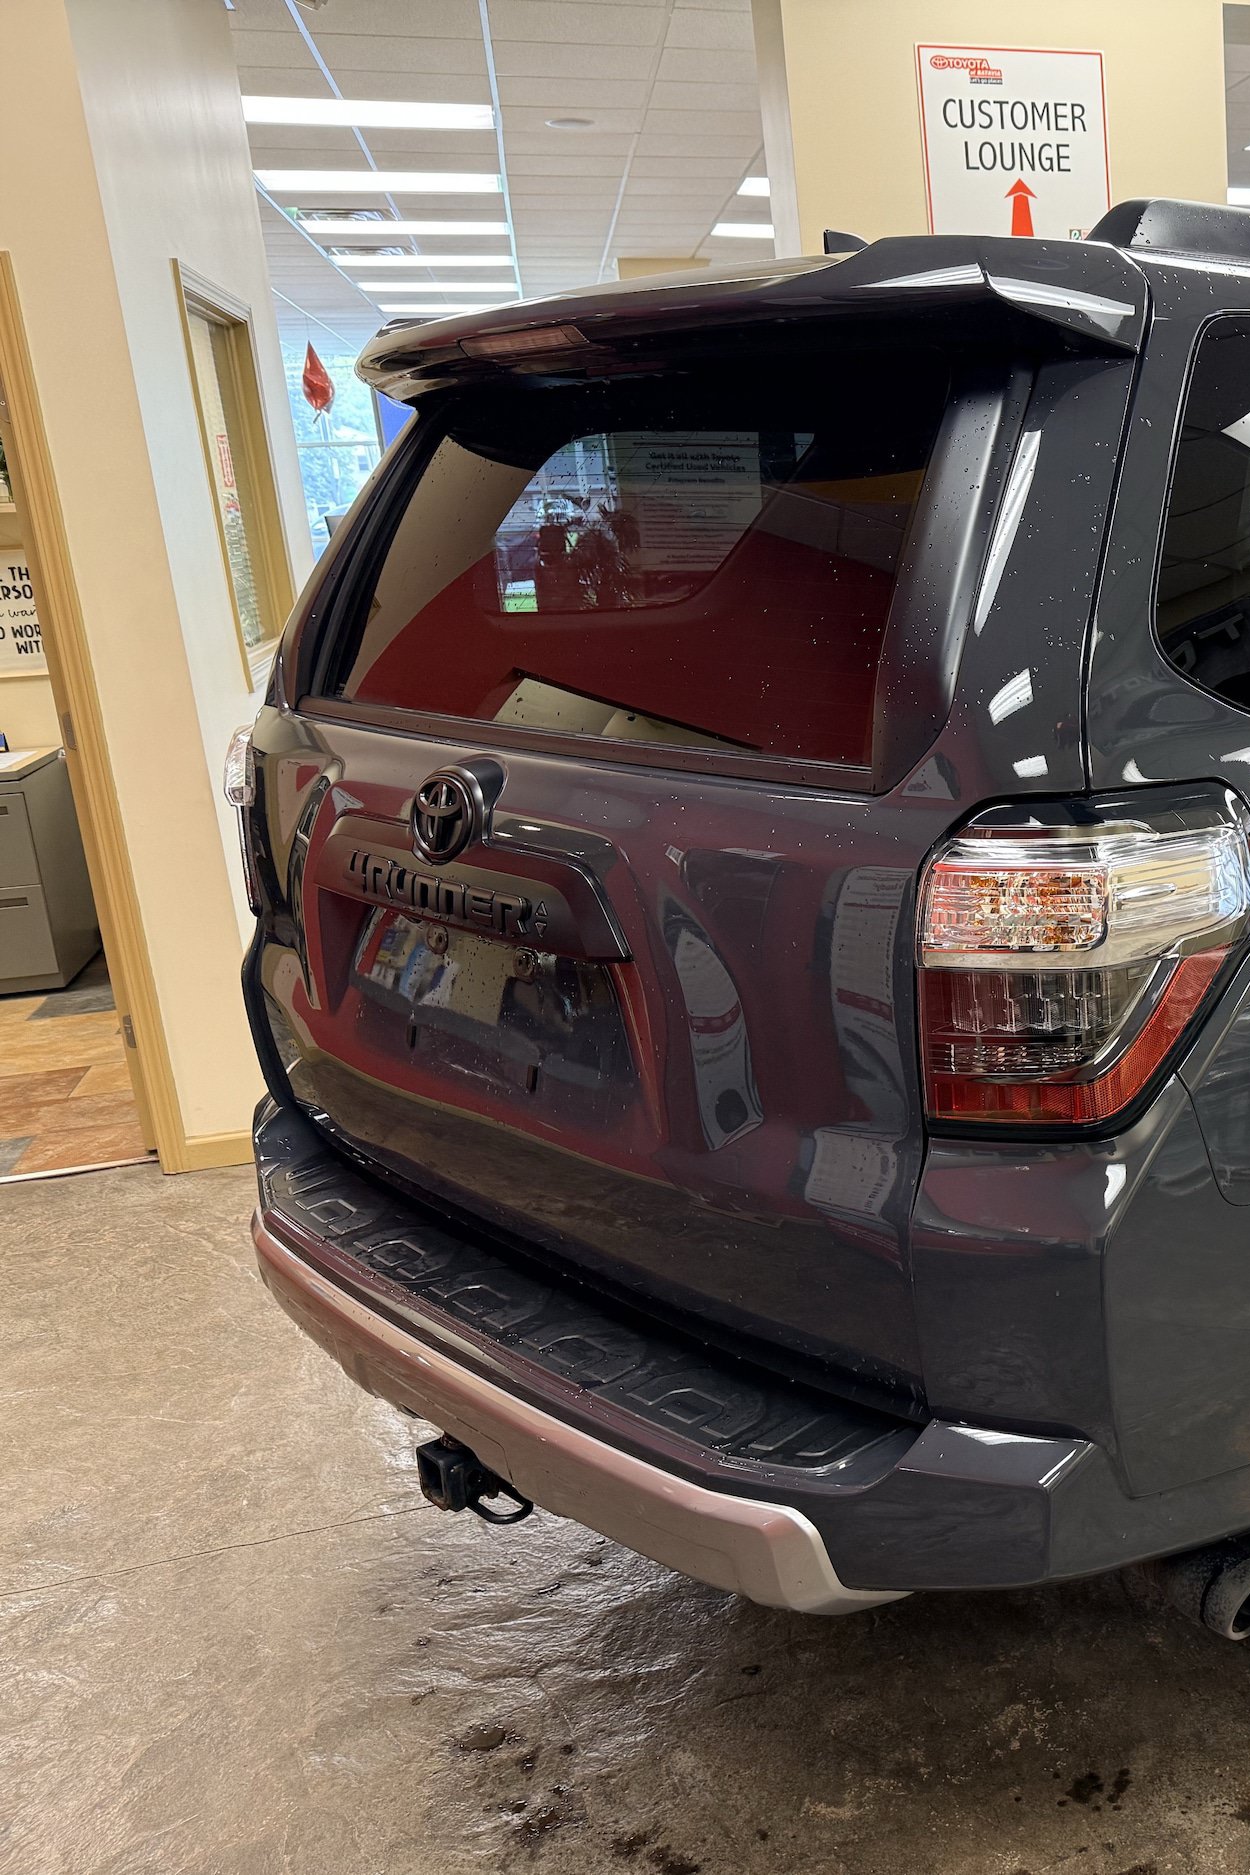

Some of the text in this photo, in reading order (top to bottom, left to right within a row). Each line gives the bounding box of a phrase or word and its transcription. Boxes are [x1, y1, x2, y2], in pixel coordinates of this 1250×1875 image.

[947, 58, 989, 69] TOYOTA
[942, 98, 1087, 132] CUSTOMER
[964, 141, 1072, 173] LOUNGE
[0, 584, 34, 600] RSO
[342, 850, 532, 937] 4RUNNER
